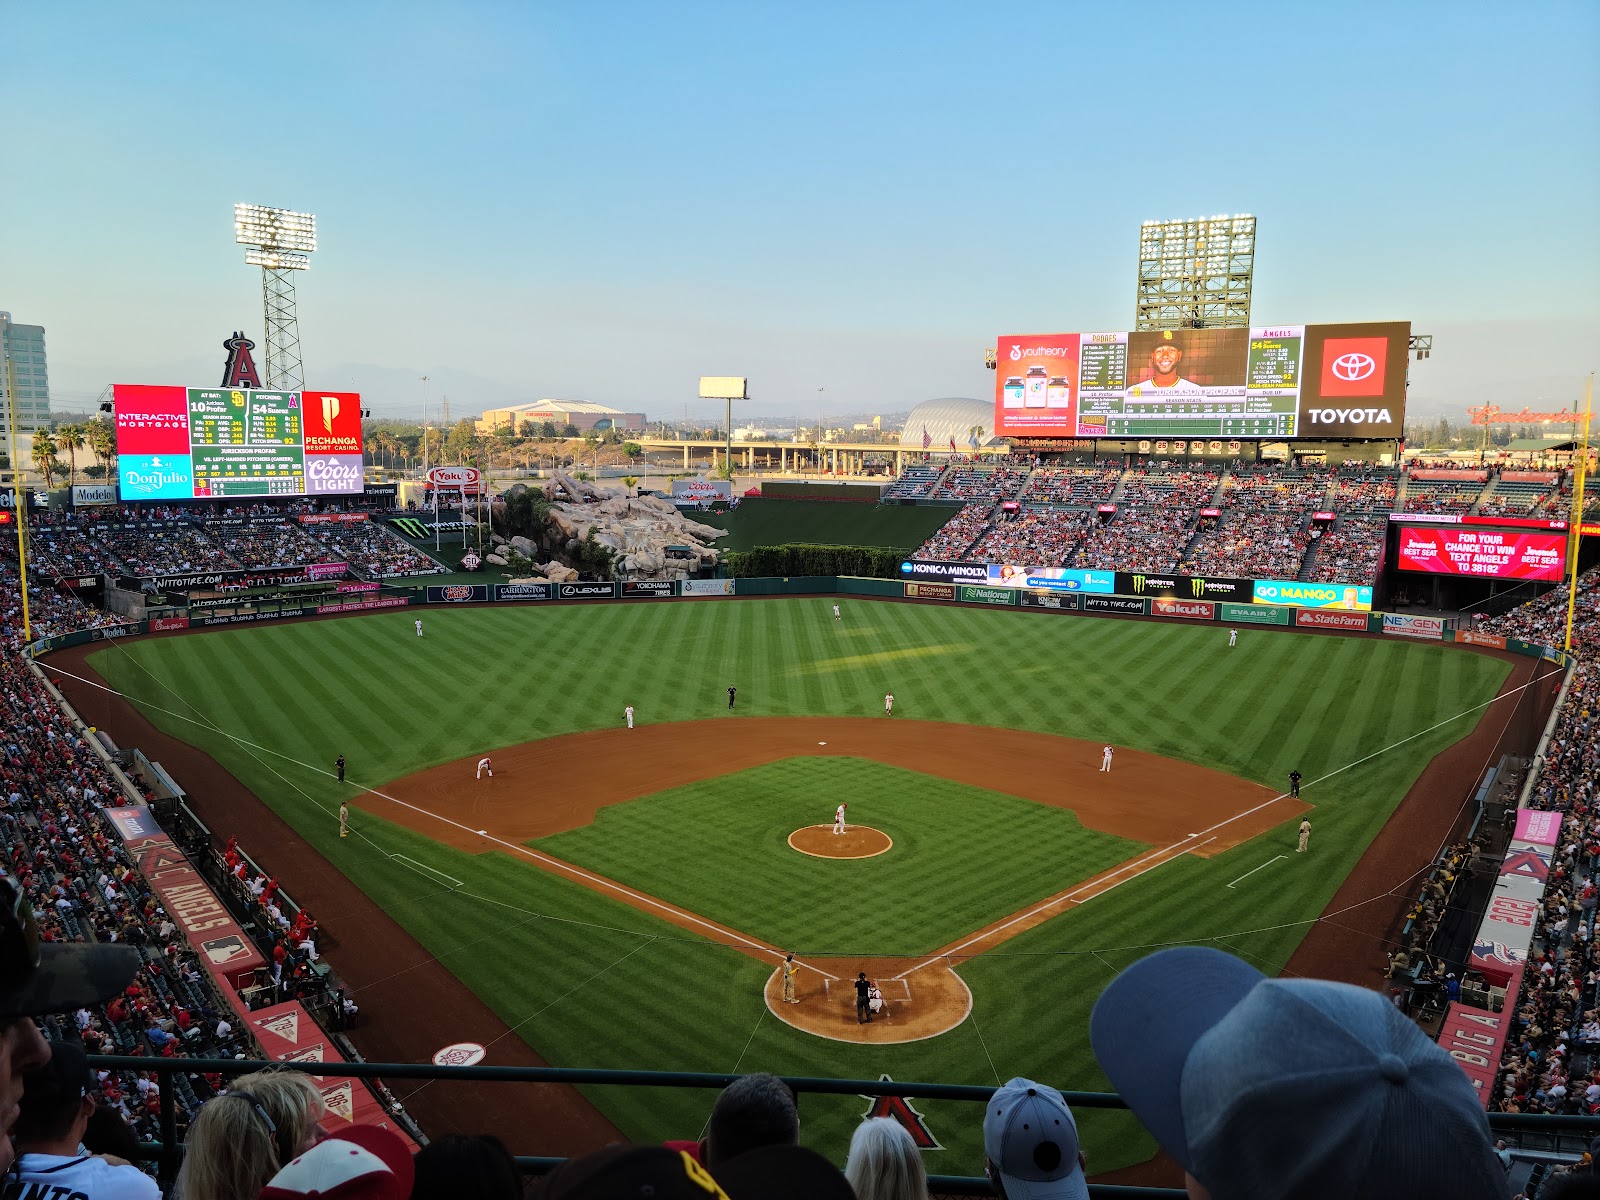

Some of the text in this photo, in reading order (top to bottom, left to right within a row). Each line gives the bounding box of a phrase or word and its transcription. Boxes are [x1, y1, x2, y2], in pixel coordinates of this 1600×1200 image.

[1021, 346, 1067, 358] youtheory
[1154, 388, 1240, 396] JURICKSON PROFAR
[190, 402, 206, 412] 10
[252, 404, 267, 414] 54
[118, 413, 187, 421] INTERACTIVE
[1308, 408, 1392, 424] TOYOTA
[305, 436, 357, 445] PECHANGA
[308, 459, 359, 480] Coors
[125, 471, 188, 489] Don Julio
[438, 472, 473, 480] Yakut
[315, 479, 354, 491] LIGHT
[79, 489, 111, 501] Modelo
[1458, 533, 1503, 545] FOR YOUR
[1421, 549, 1438, 557] SEAT
[1444, 543, 1515, 555] CHANCE TO WIN
[1449, 552, 1509, 565] TEXT ANGELS
[1540, 557, 1559, 565] SEAT
[913, 564, 988, 577] KONICA MINOLTA
[1458, 562, 1499, 574] TO 38182
[157, 575, 223, 589] NITTOTIRE.COM
[1145, 579, 1175, 588] MONSTER
[1205, 583, 1236, 591] MONSTER
[500, 585, 546, 594] CARRINGTON
[575, 586, 612, 594] LEXUS
[919, 586, 952, 594] PECHANGA
[976, 588, 1011, 600] National
[1256, 586, 1337, 601] GO MANGO
[1087, 598, 1142, 609] NITTO TIRE.COM
[1155, 602, 1210, 616] Yakult
[204, 617, 229, 625] StubHub
[1385, 615, 1441, 630] NEXGEN
[103, 628, 126, 638] Modelo
[161, 882, 232, 932] ANGELS
[1459, 1012, 1500, 1029] A
